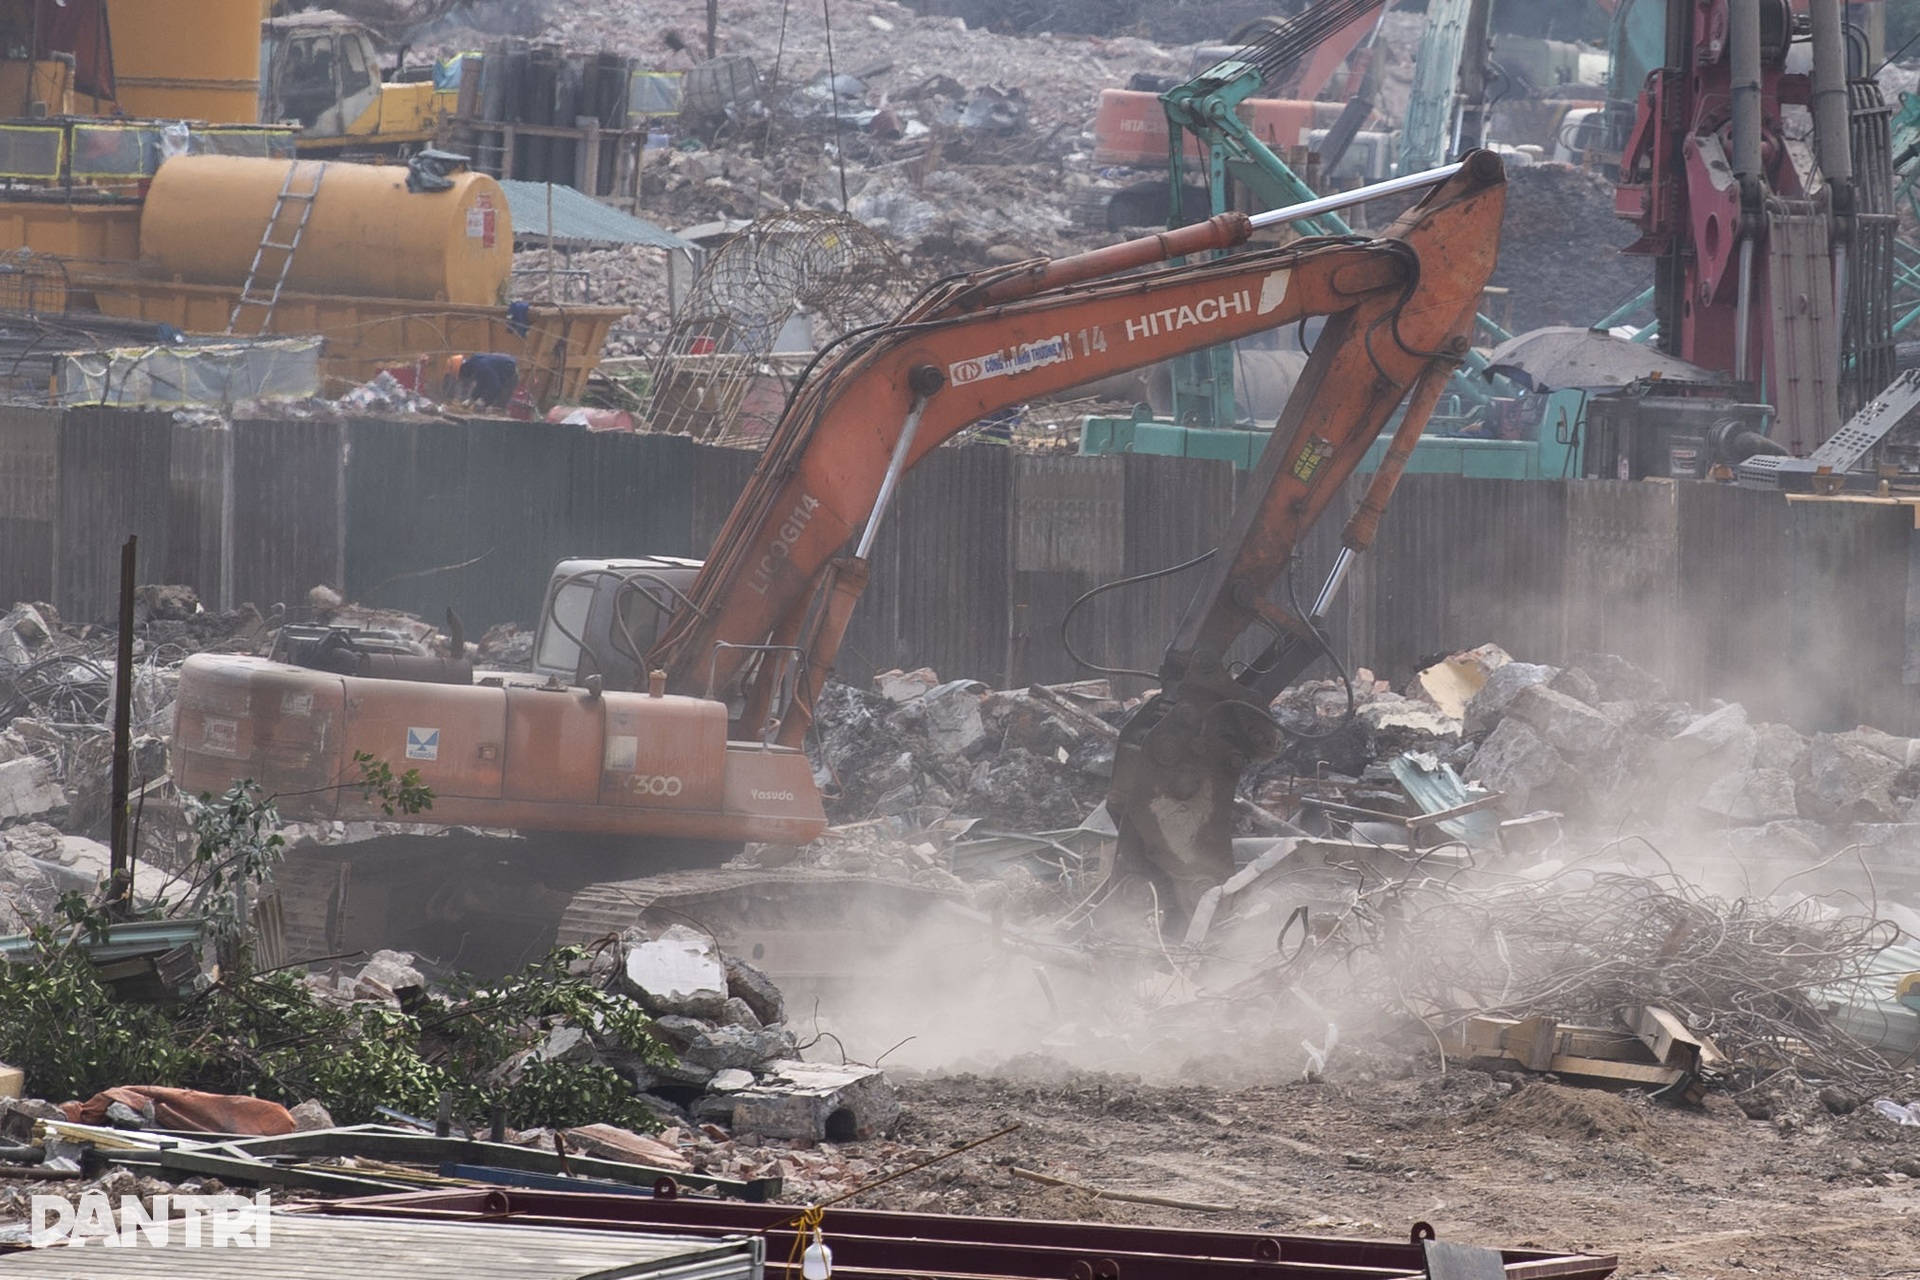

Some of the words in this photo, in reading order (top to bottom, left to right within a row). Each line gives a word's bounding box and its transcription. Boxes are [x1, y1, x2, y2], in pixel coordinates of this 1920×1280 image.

[1125, 289, 1252, 341] HITACHI
[1077, 325, 1108, 357] 14
[750, 789, 794, 801] Yasuda
